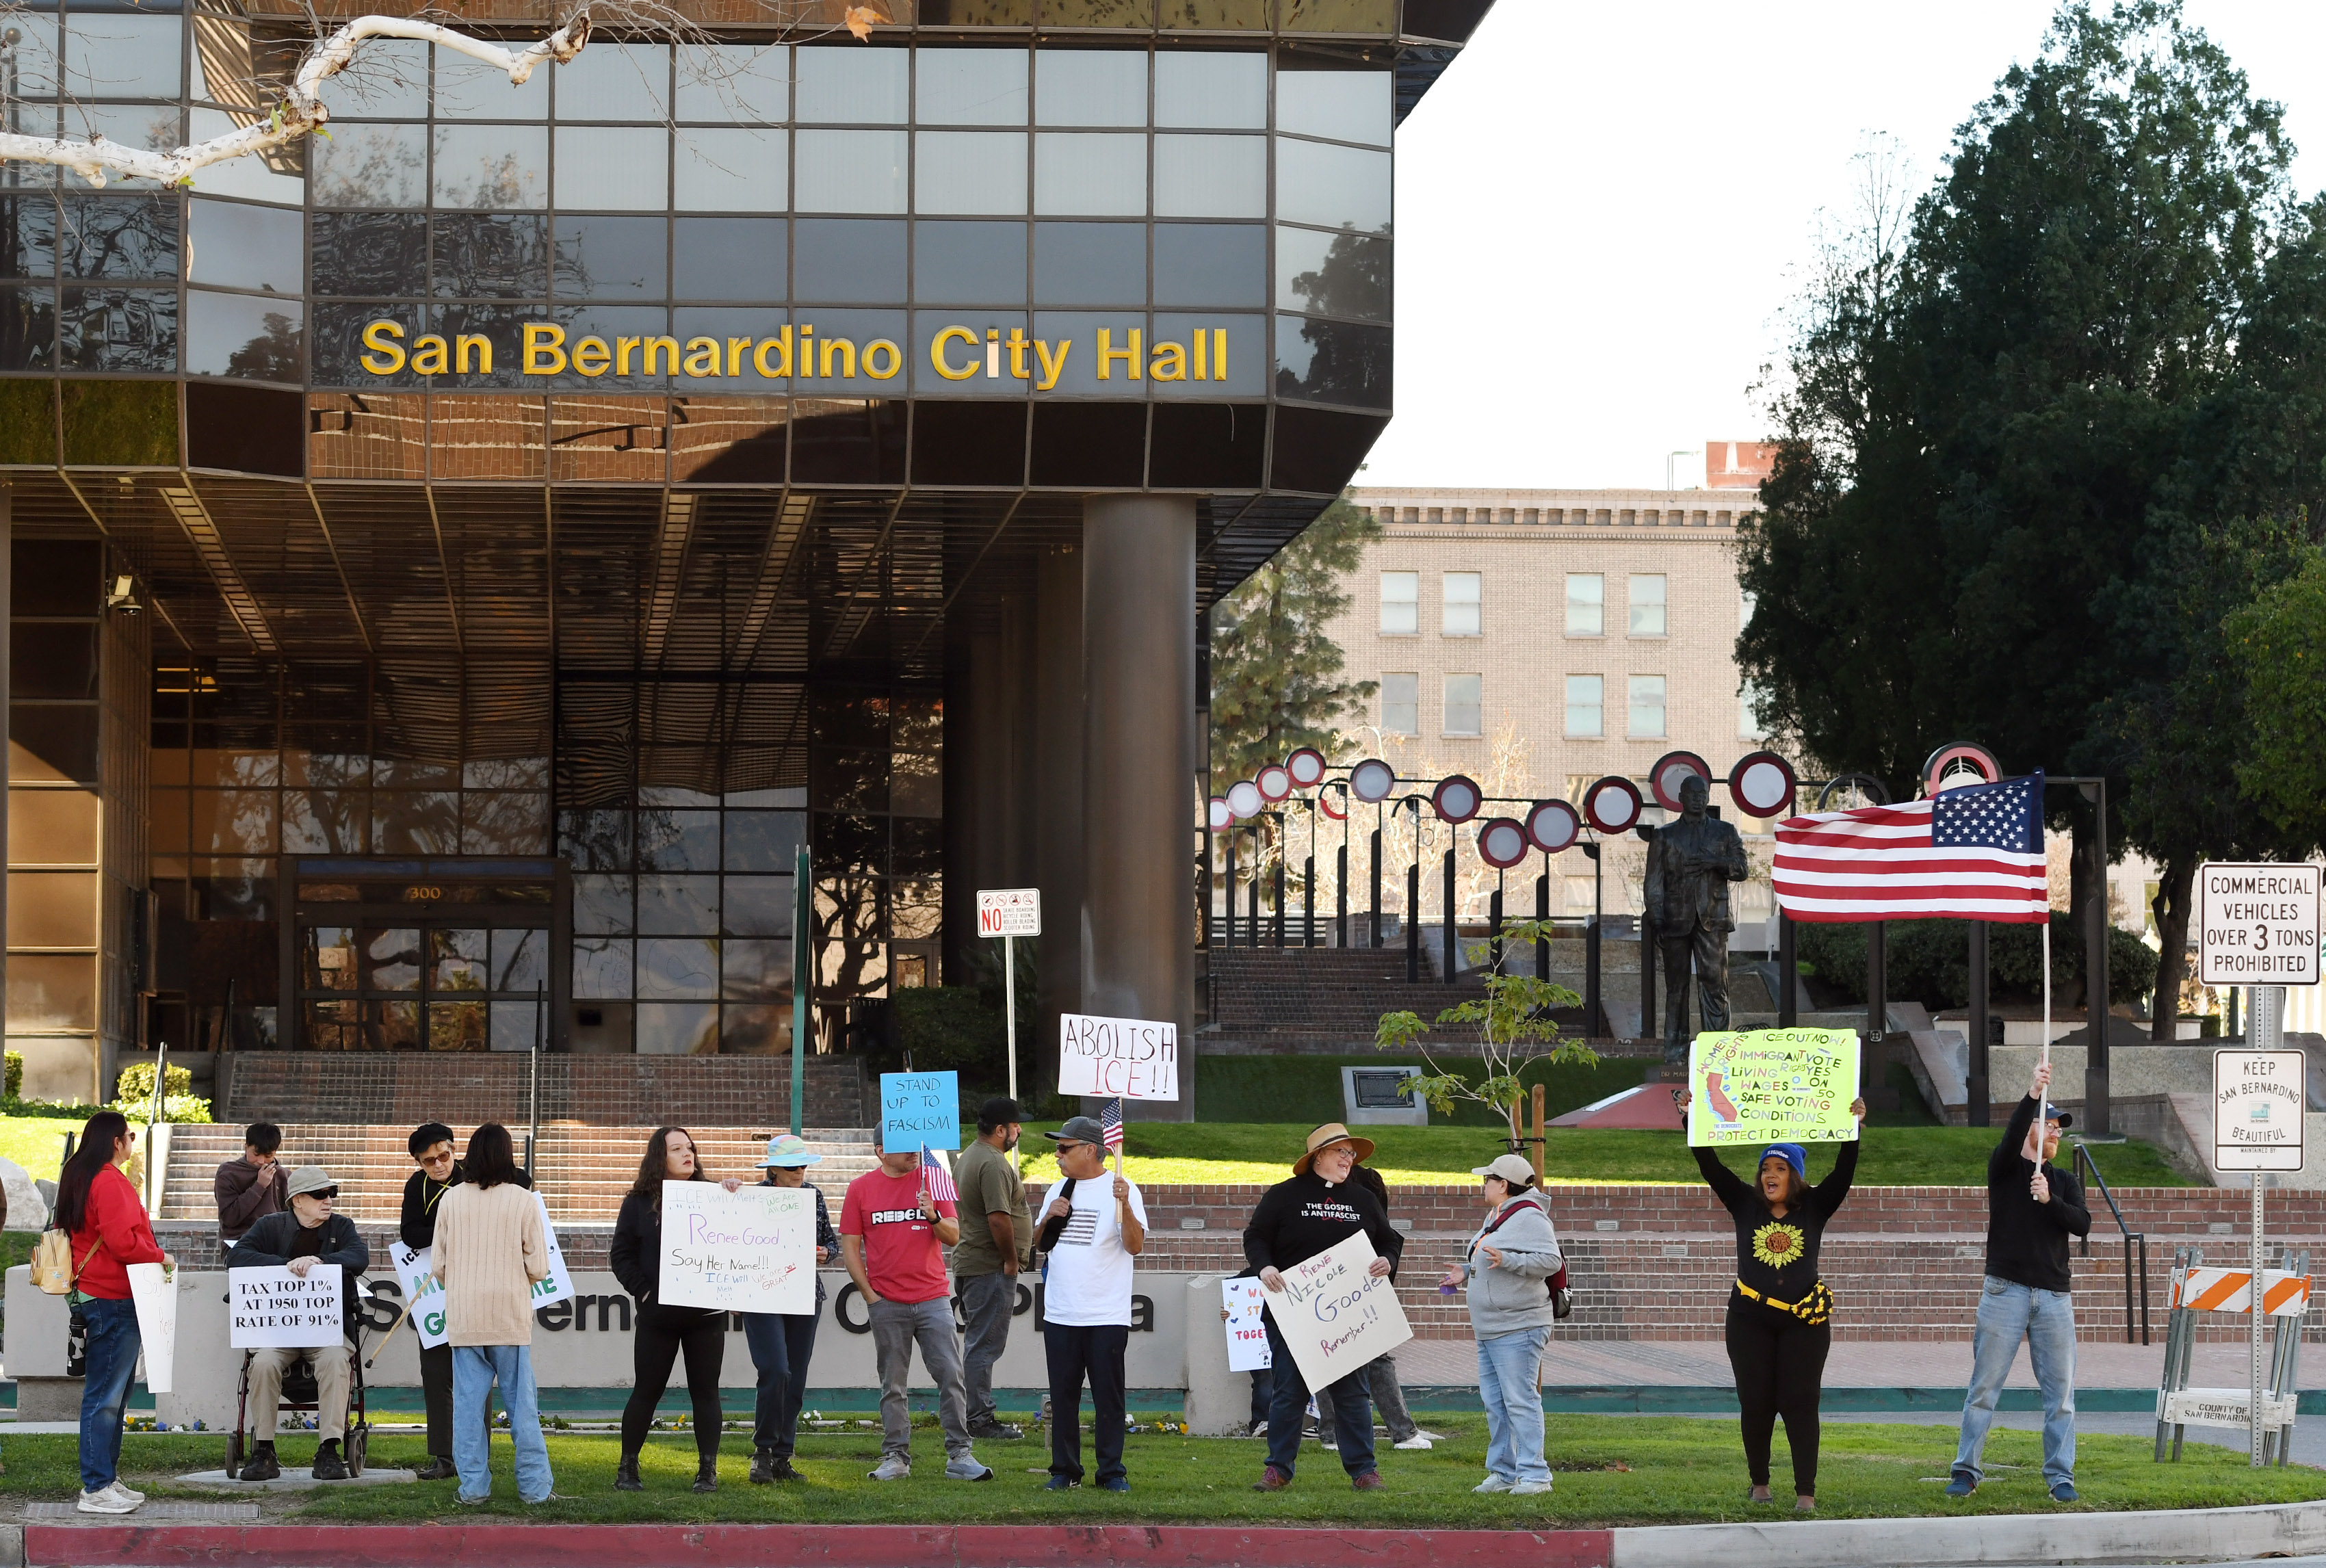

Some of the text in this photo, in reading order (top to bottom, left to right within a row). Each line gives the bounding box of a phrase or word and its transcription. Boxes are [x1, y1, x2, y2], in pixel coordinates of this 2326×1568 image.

[360, 318, 1227, 391] San Bernardino City Hall
[410, 887, 441, 899] 300
[2210, 876, 2313, 895] COMMERCIAL
[2223, 903, 2299, 921] VEHICLES
[982, 908, 1002, 932] NO
[2207, 924, 2314, 952] OVER 3 TONS
[2214, 955, 2306, 972] PROHIBITED
[1064, 1018, 1173, 1062] ABOLISH
[1762, 1033, 1846, 1047] ICE OUT NOW!
[1697, 1036, 1732, 1075] WOMEN
[1806, 1053, 1842, 1069] VOTE
[1806, 1066, 1831, 1077] YES
[2243, 1061, 2276, 1075] KEEP
[896, 1077, 941, 1092] STAND
[1090, 1058, 1168, 1097] ICE!!
[1809, 1077, 1829, 1088] ON
[1740, 1080, 1789, 1091] WAGES
[2219, 1082, 2300, 1104] SAN BERNARDINO
[1740, 1092, 1772, 1104] SAFE
[1815, 1088, 1835, 1099] 50
[887, 1095, 940, 1109] UP TO
[888, 1115, 950, 1132] FASCISM
[1708, 1127, 1853, 1142] PROTECT DEMOCRACY
[2232, 1126, 2286, 1142] BEAUTIFUL
[666, 1188, 704, 1203] ICE
[731, 1192, 756, 1204] Melt
[766, 1196, 781, 1207] We
[780, 1202, 800, 1213] ONE
[1310, 1210, 1361, 1220] ANTIFASCIST
[1324, 1203, 1355, 1212] GOSPEL
[689, 1213, 779, 1246] Renee Good
[670, 1249, 770, 1274] Say Her Name!!!
[1298, 1254, 1333, 1279] RENE
[705, 1272, 729, 1283] ICE
[761, 1274, 789, 1291] GREAT
[238, 1280, 332, 1294] TAX TOP 1%
[242, 1296, 335, 1310] AT 1950 TOP
[235, 1314, 339, 1328] RATE OF 91%
[2184, 1409, 2251, 1424] SAN BERNARDIN
[2198, 1403, 2249, 1415] COUNTY OF
